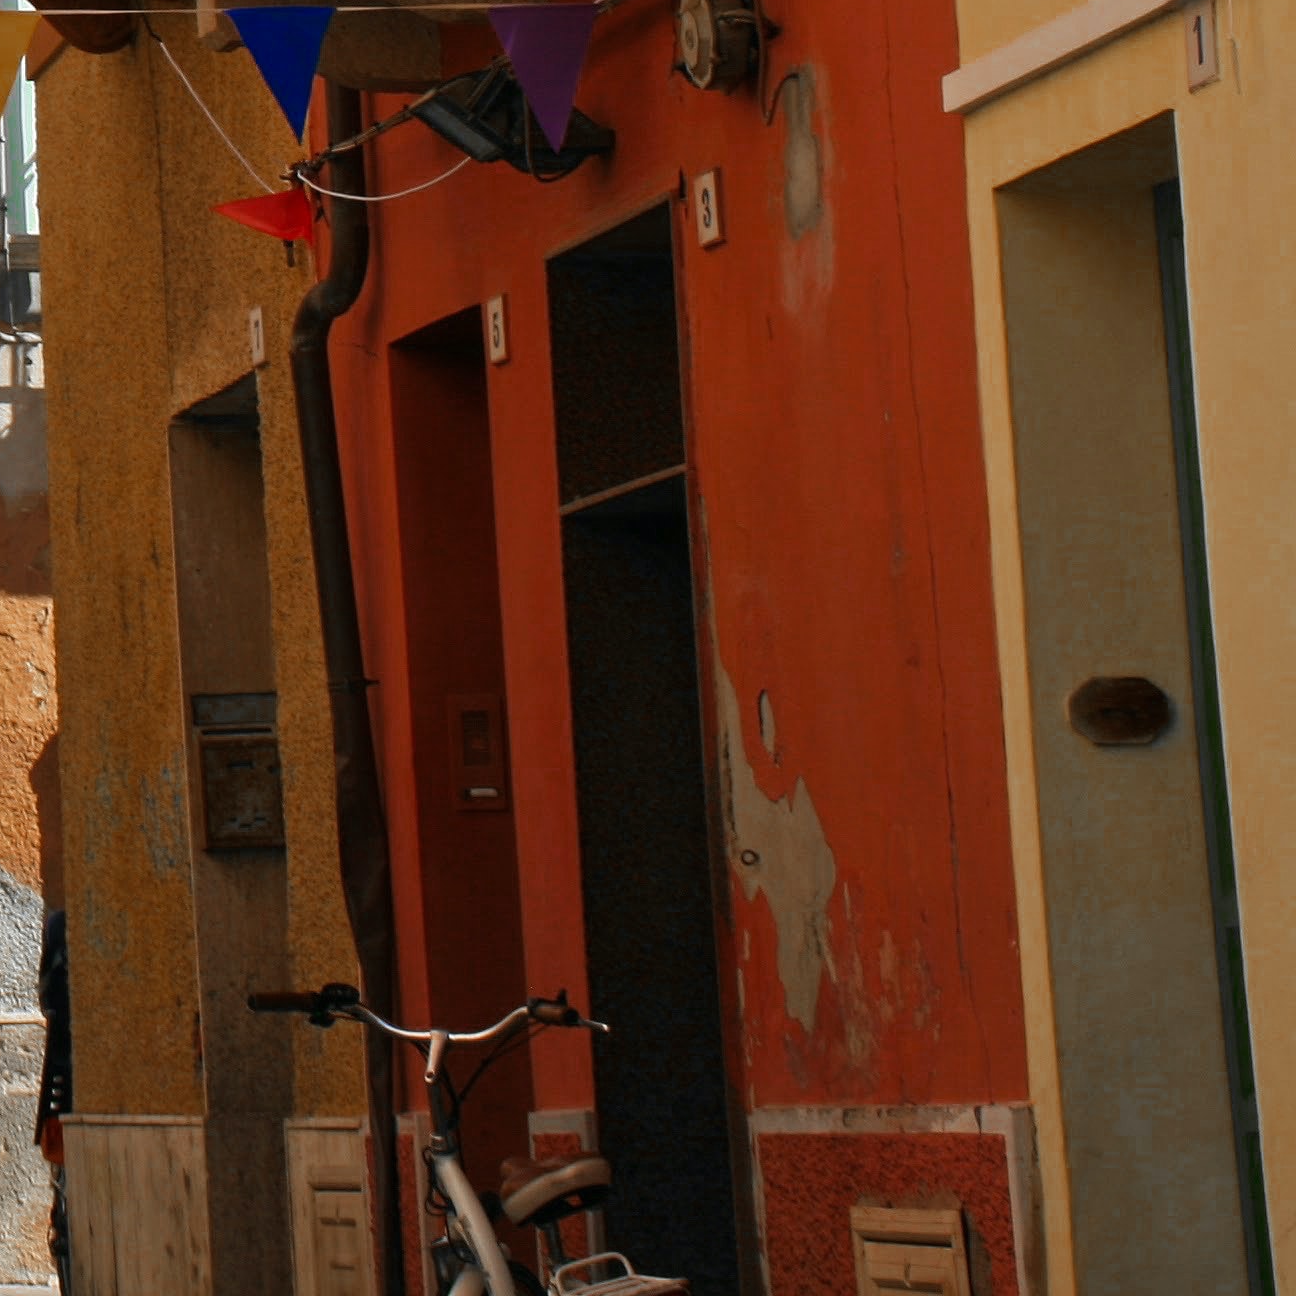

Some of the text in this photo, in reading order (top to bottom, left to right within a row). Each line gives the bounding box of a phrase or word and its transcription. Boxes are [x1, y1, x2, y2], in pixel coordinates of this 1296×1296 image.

[1193, 15, 1204, 65] 1
[701, 188, 712, 229] 3
[493, 311, 500, 349] 5
